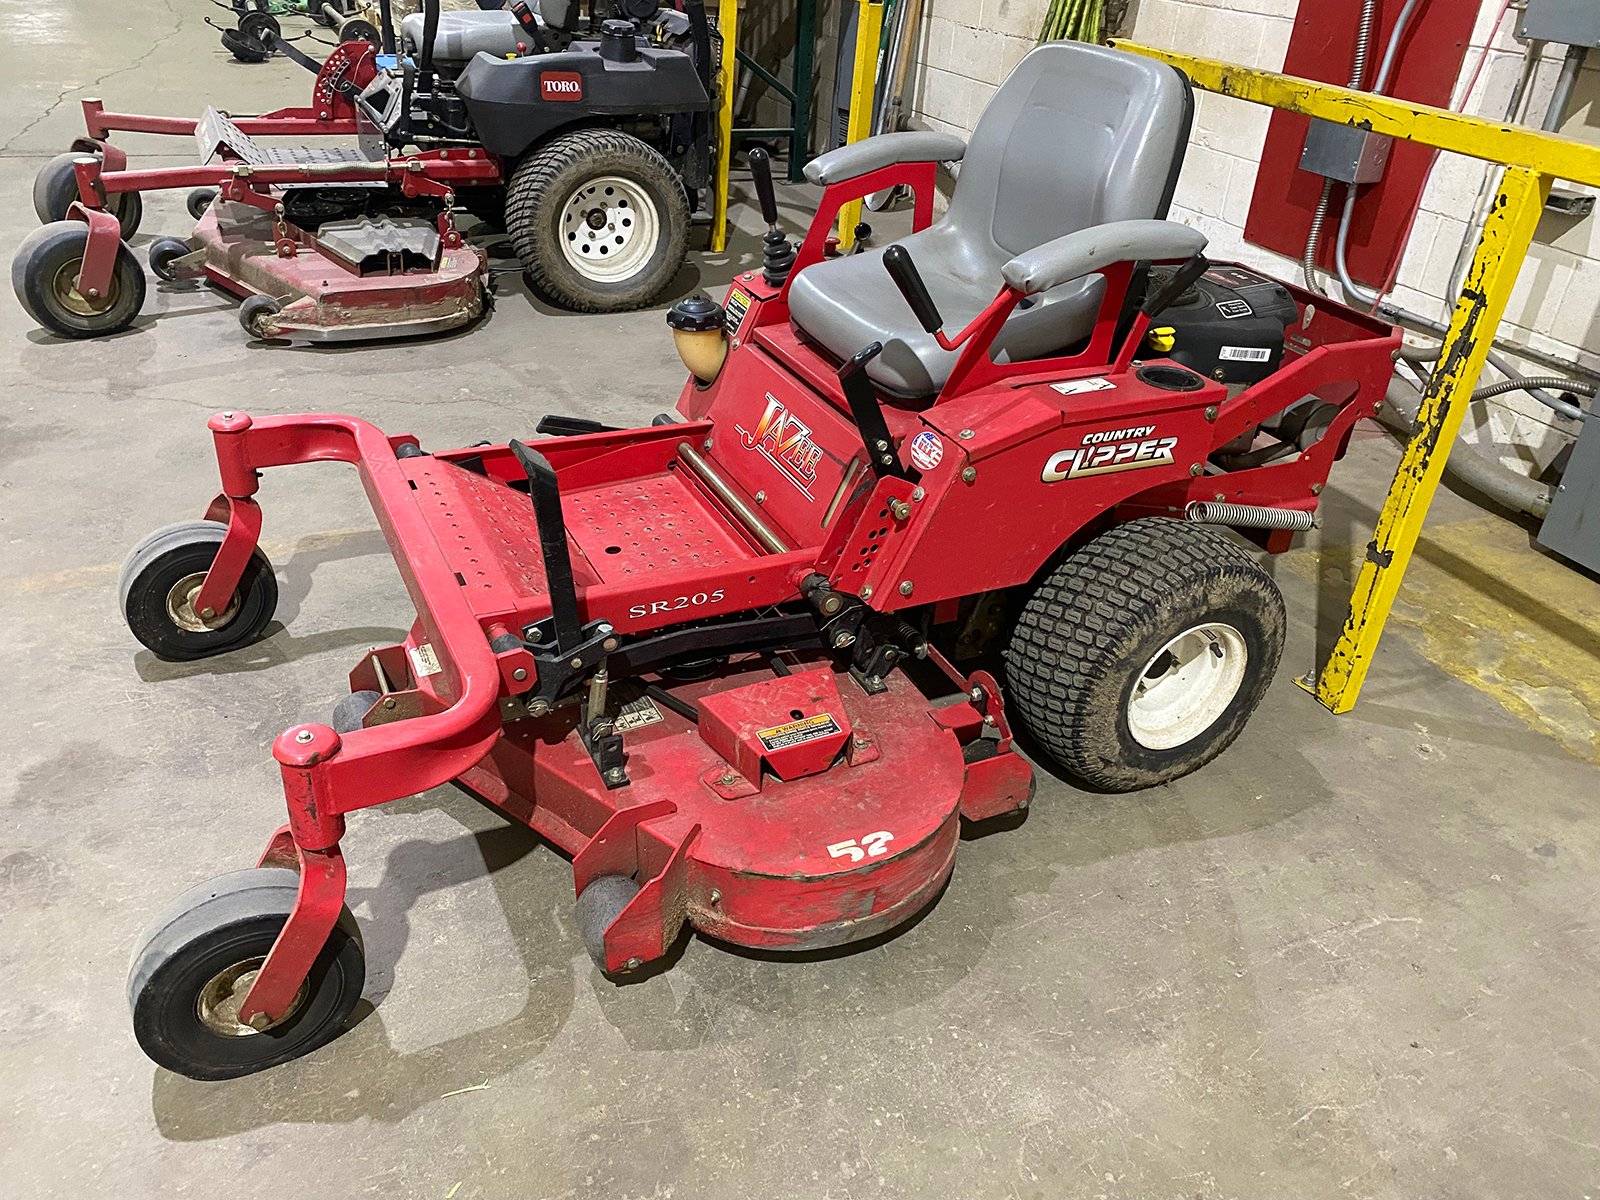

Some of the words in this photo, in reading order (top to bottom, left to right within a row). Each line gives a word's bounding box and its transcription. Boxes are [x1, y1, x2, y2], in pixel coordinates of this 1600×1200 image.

[543, 80, 580, 93] TORO
[1081, 425, 1156, 446] COUNTRY
[1041, 436, 1178, 482] CLIPPER
[629, 589, 725, 619] SR205
[826, 830, 895, 863] 52
